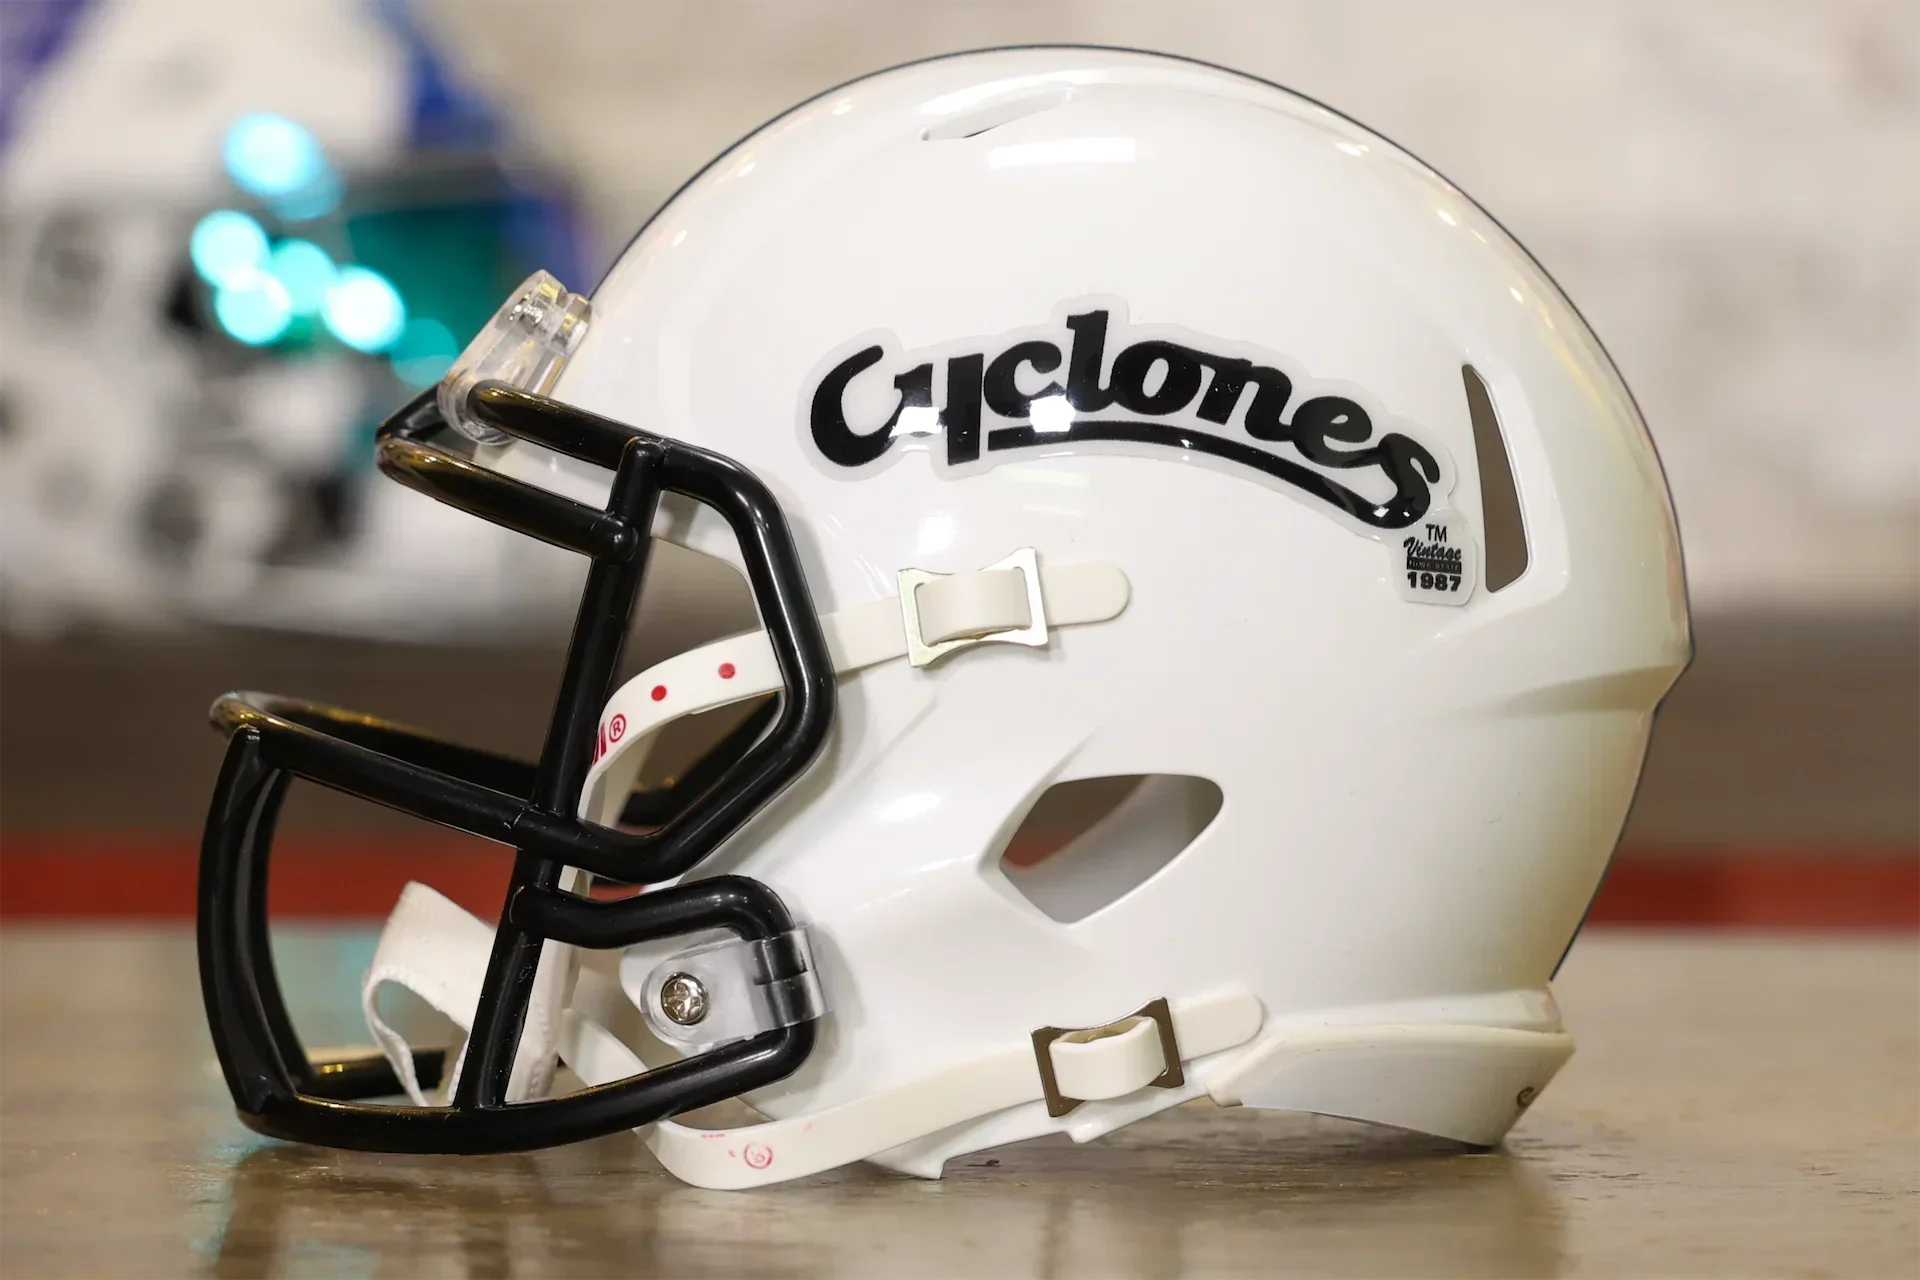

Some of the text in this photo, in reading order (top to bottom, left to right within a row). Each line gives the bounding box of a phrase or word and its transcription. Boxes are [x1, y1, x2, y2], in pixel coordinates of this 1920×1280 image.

[811, 310, 1440, 529] Cyclones
[1425, 523, 1447, 542] TM
[1403, 536, 1462, 560] Vintage
[1407, 571, 1461, 592] 1987
